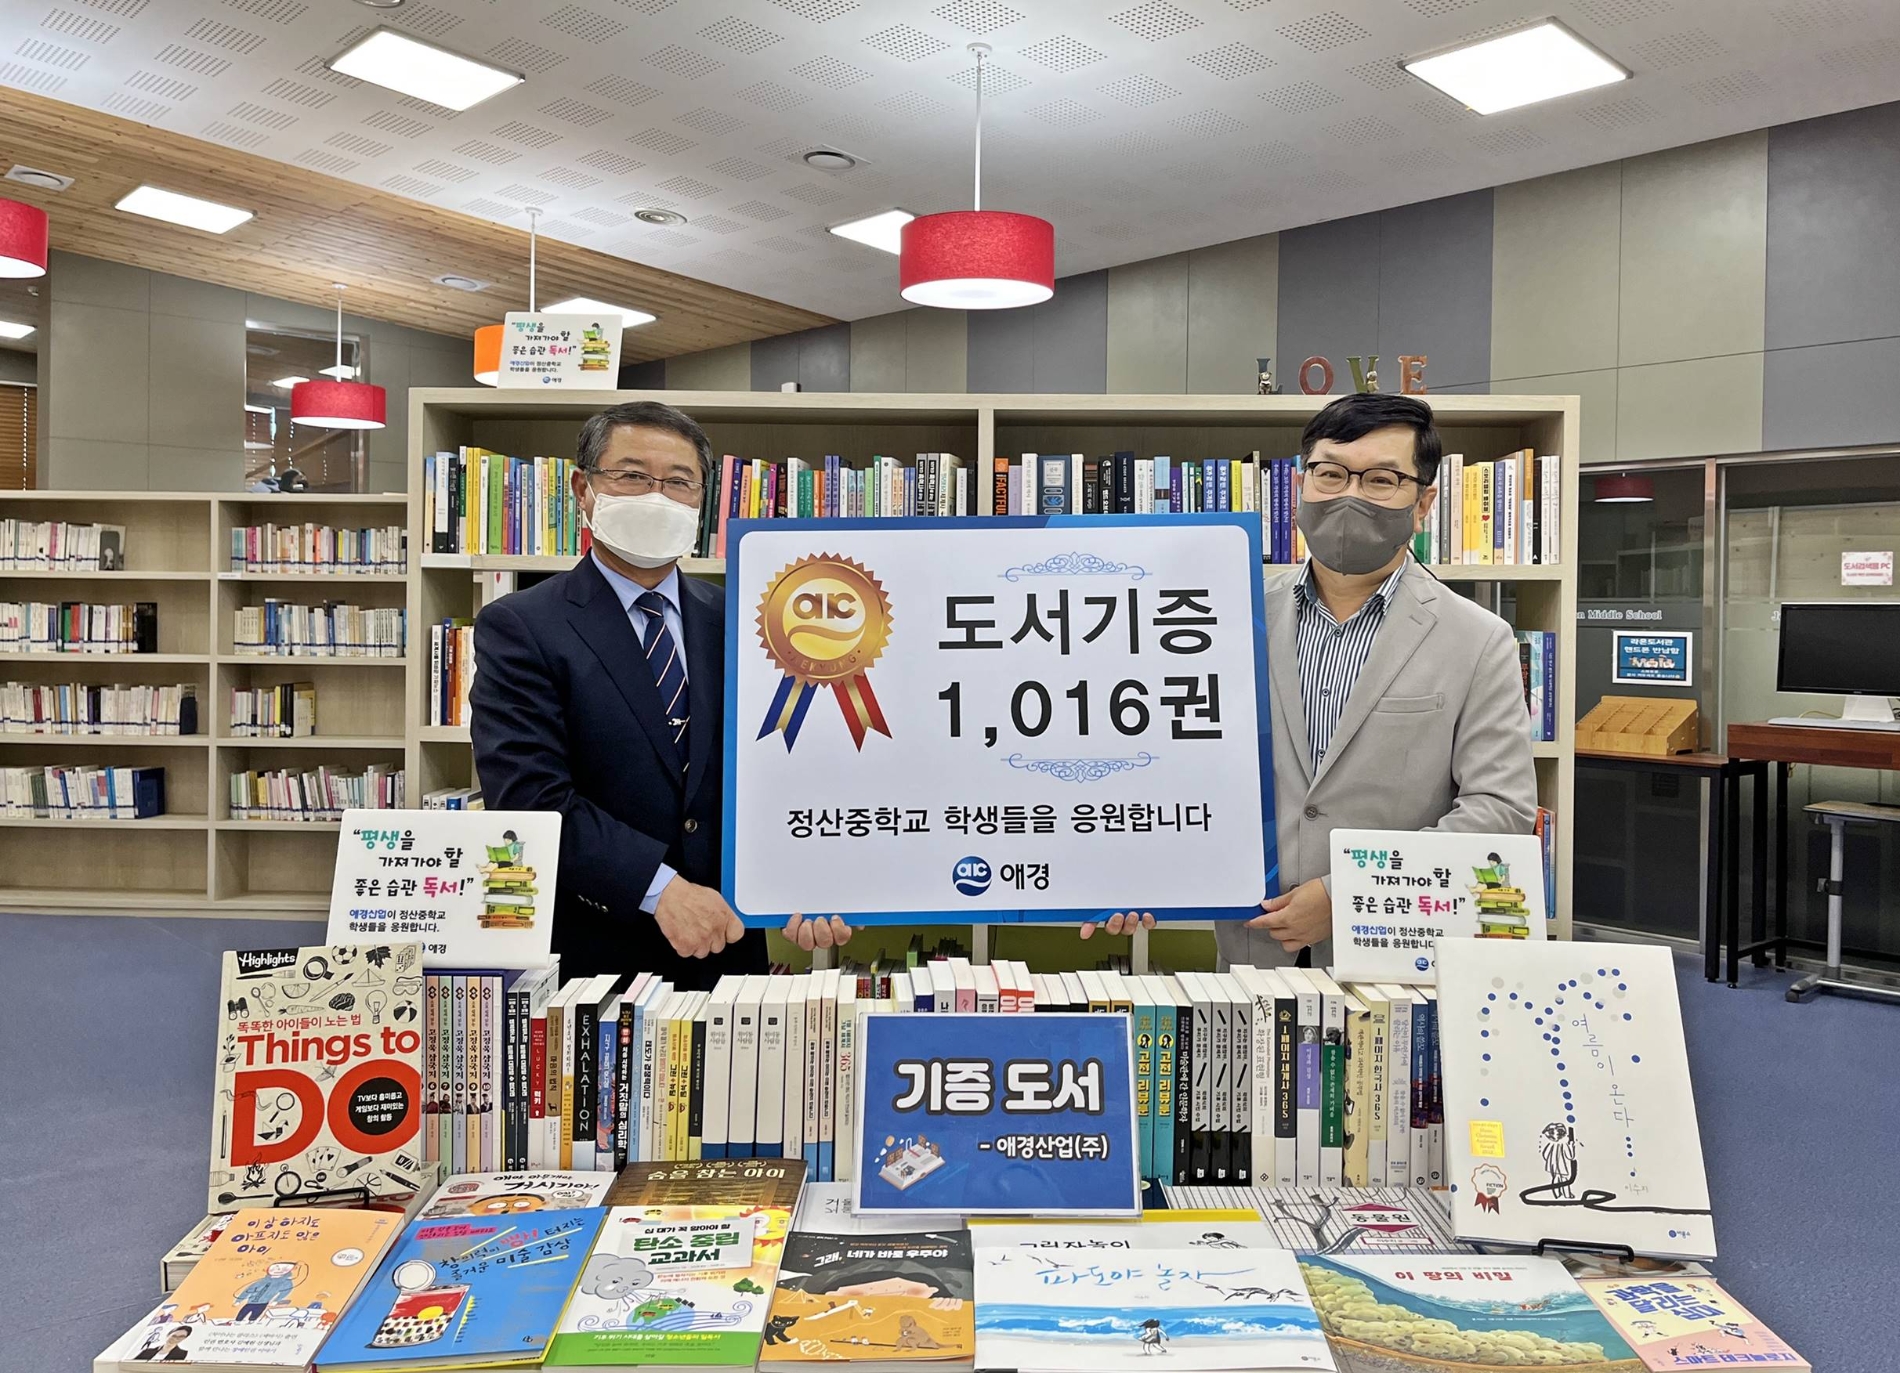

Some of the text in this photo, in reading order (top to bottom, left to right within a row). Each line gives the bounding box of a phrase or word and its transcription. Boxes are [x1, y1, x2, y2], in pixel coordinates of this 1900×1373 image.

[1256, 355, 1428, 395] LOVE
[1880, 562, 1891, 570] PC
[938, 588, 1218, 656] 도서기증
[1588, 610, 1623, 620] Middle
[1626, 610, 1662, 620] School
[938, 673, 1223, 748] 1,016권
[786, 803, 1212, 838] 정산중학교 학생들을 응원합니다
[353, 829, 416, 850] “평생을
[379, 848, 463, 868] 가져가야 할
[1344, 848, 1404, 870] “평생을
[354, 876, 474, 898] 좋은 습관 독서!”
[1000, 862, 1051, 892] 애경
[1371, 868, 1452, 888] 가져가야 할
[350, 910, 446, 920] 애경산업이 정산중학교
[1352, 896, 1466, 916] 좋은 습관 독서!”
[349, 922, 440, 932] 학생들을 응원합니다.
[1352, 925, 1444, 937] 애경산업이 정산중학교
[428, 944, 447, 954] 애경
[1353, 937, 1389, 948] 학생들을
[238, 953, 296, 968] Highlights
[237, 1014, 362, 1033] 똑똑한 아이들이 노는 법
[237, 1026, 420, 1066] Things to
[1256, 1029, 1265, 1078] 확장된 표현형
[1394, 1040, 1400, 1053] 이유
[1416, 1036, 1425, 1051] 쓸모
[428, 1029, 437, 1091] 고정욱 삼국지 6
[441, 1029, 450, 1091] 고정욱 삼국지 7
[643, 1040, 653, 1099] 태도가 경쟁력이다
[840, 1051, 851, 1072] 365
[580, 1014, 590, 1132] EXHALATION
[1374, 1066, 1383, 1091] 한국사
[1572, 1013, 1634, 1128] 여름이 온다
[456, 1082, 464, 1092] 8
[469, 1082, 477, 1091] 9
[482, 1082, 491, 1091] 10
[894, 1060, 993, 1112] 기증
[1004, 1060, 1101, 1112] 도서
[1137, 1051, 1150, 1116] 고전 리뷰툰
[1179, 1051, 1189, 1122] 미술관에 간 인문학자
[355, 1102, 404, 1113] 게임보다 재미있는
[357, 1094, 378, 1102] TV보다
[230, 1059, 421, 1167] DO
[618, 1082, 629, 1149] 거짓말의 심리학
[996, 1134, 1108, 1160] 애경산업(주)
[648, 1168, 786, 1180] 숨을 참는 아이
[504, 1182, 600, 1191] 거시기야!
[247, 1216, 320, 1229] 이상하지도
[544, 1217, 586, 1236] 터지는
[1351, 1214, 1412, 1222] 동물원
[231, 1229, 320, 1243] 아프지도 않은
[634, 1231, 740, 1251] 탄소 중립
[237, 1244, 272, 1254] 아이
[496, 1249, 531, 1264] 미술
[536, 1238, 572, 1256] 감상
[648, 1249, 720, 1265] 교과서
[814, 1251, 844, 1267] 그래,
[877, 1250, 903, 1258] 바로
[906, 1249, 948, 1259] 우주야
[1036, 1264, 1257, 1291] 파도야 놀자
[1395, 1271, 1514, 1281] 이 땅의 비밀
[1629, 1294, 1700, 1314] 달리는
[1671, 1304, 1726, 1320] 십대
[1674, 1354, 1718, 1365] 스마트
